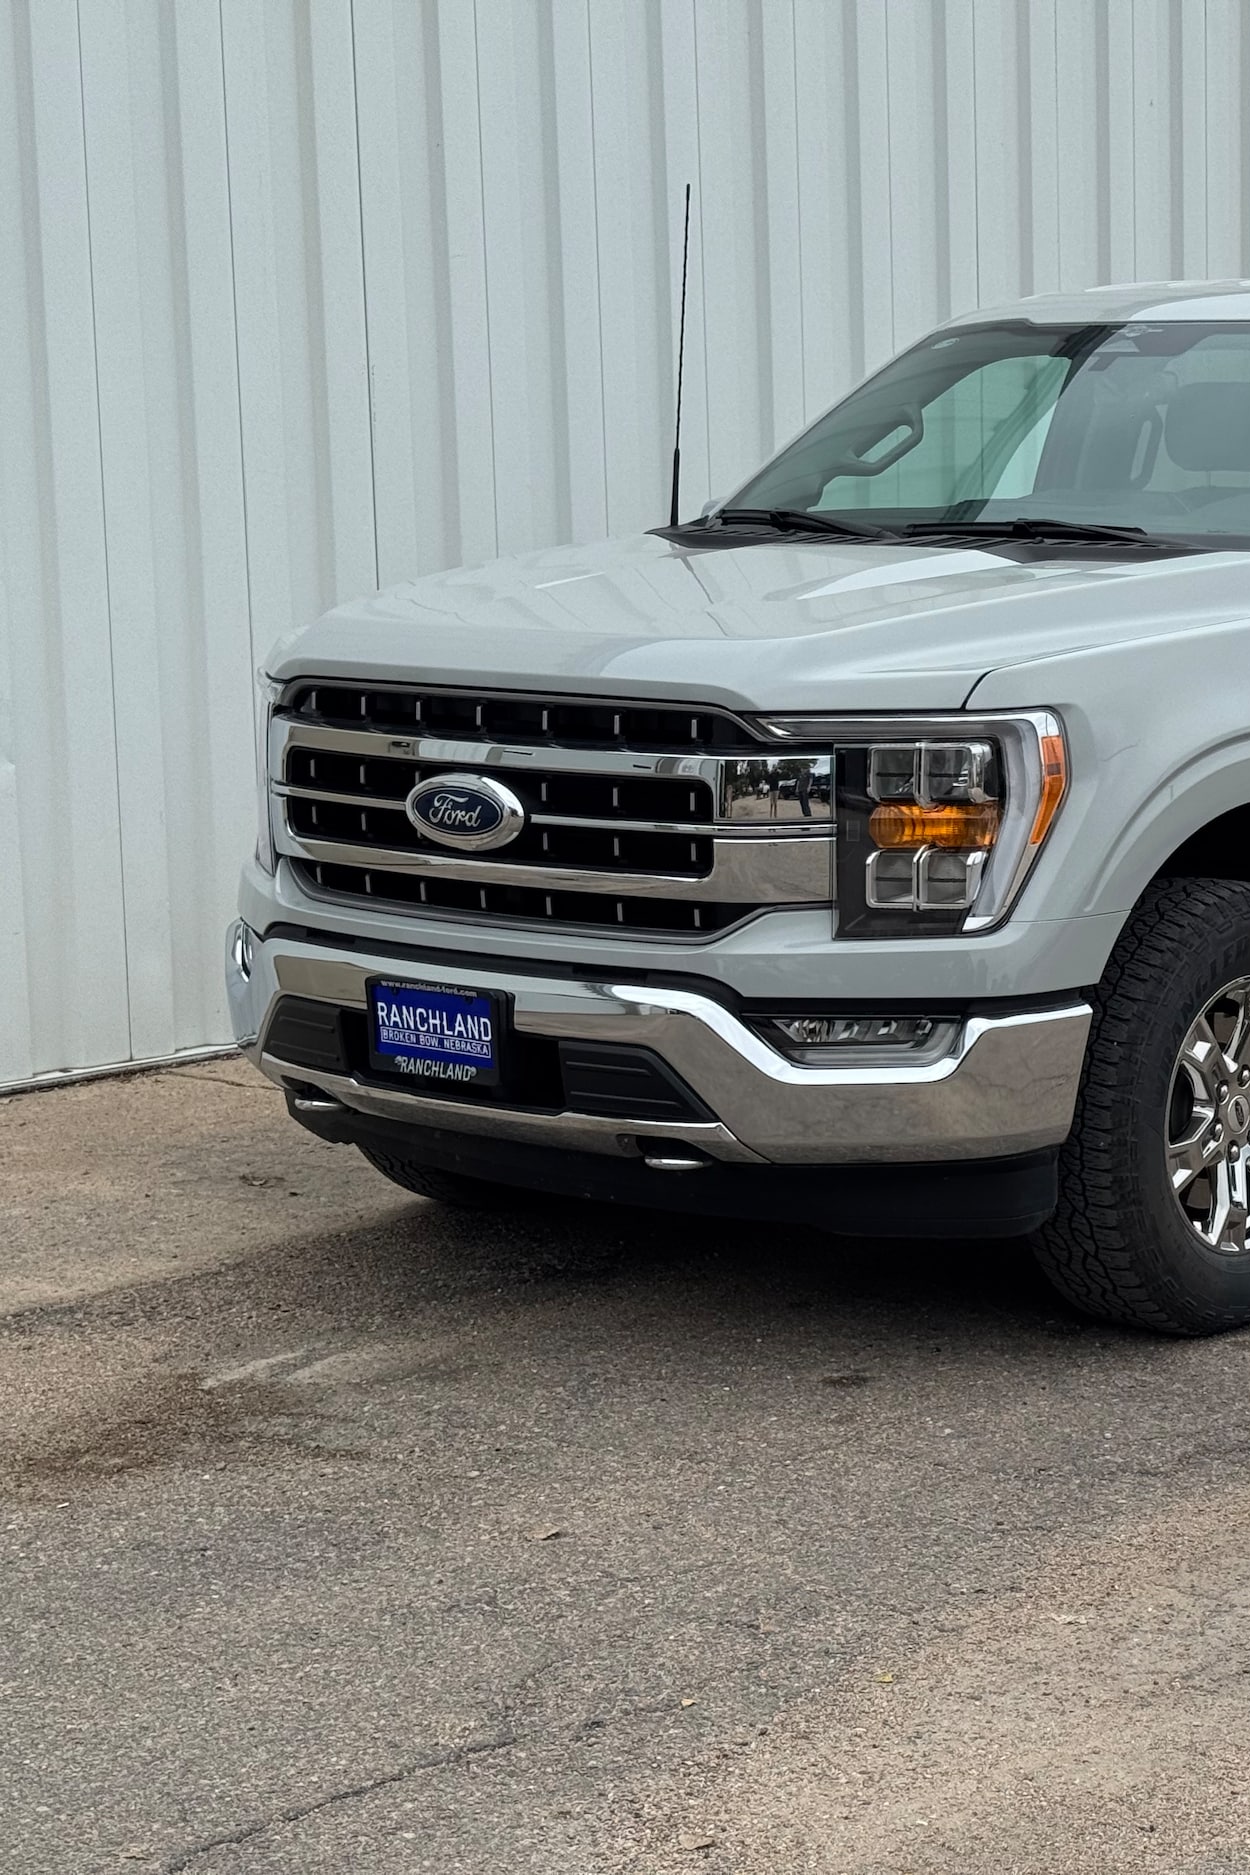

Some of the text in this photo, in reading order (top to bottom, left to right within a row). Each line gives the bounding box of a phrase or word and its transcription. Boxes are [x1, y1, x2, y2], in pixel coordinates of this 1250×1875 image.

[429, 793, 481, 827] Ford
[380, 980, 477, 997] www.ranchland-ford.com
[377, 1002, 492, 1041] RANCHLAND
[383, 1030, 416, 1044] BROKEN
[444, 1039, 489, 1055] NEBRASKA
[400, 1056, 471, 1081] RANCHLAND
